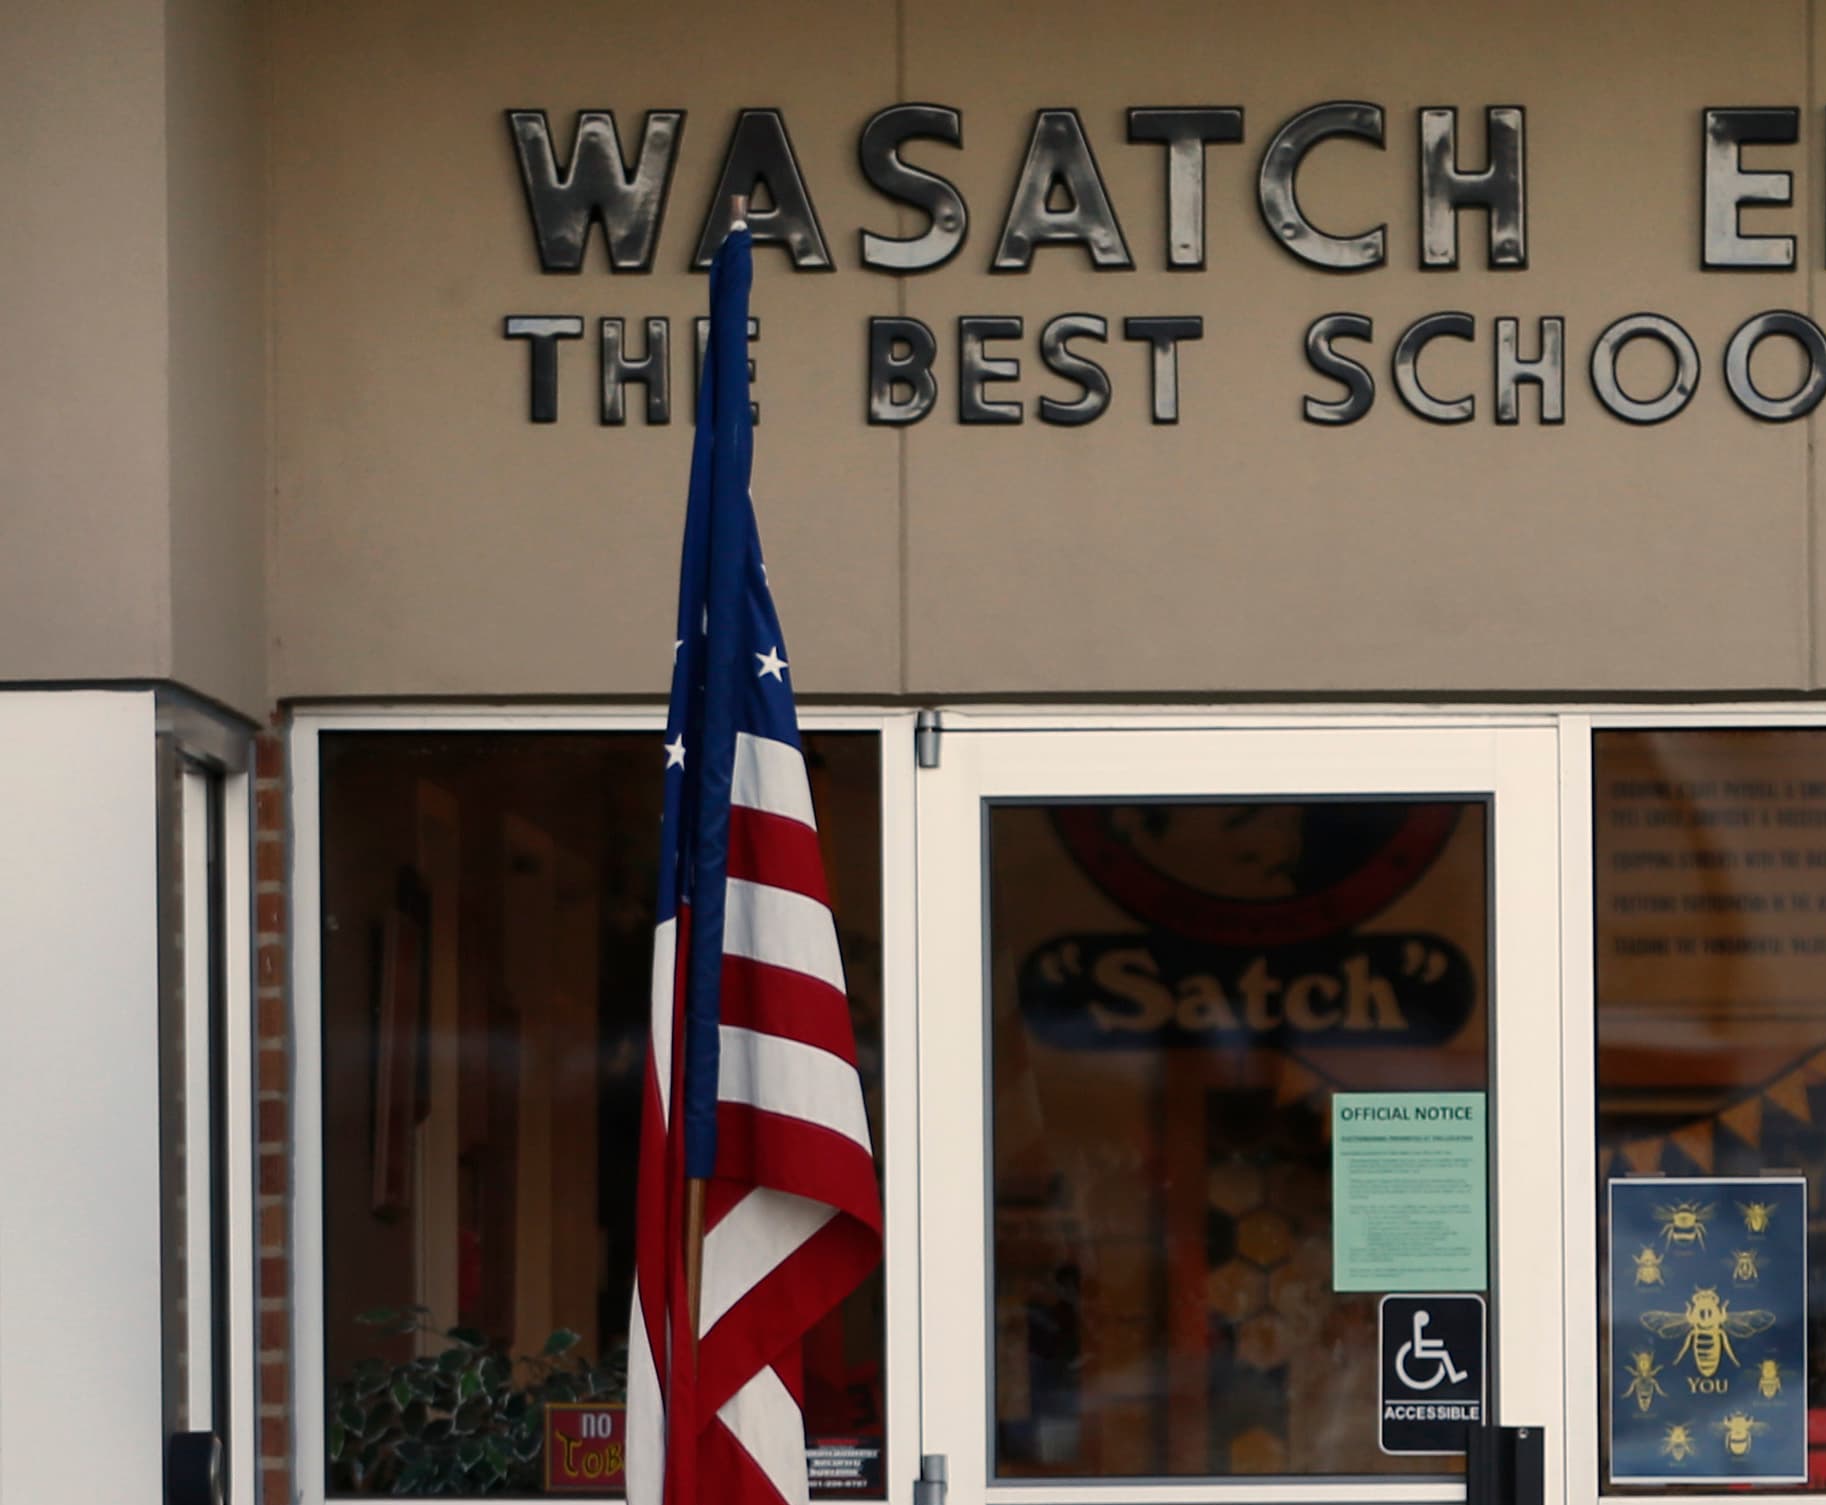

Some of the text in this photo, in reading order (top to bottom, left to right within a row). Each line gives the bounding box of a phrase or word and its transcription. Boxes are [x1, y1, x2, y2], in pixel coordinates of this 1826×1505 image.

[504, 99, 1527, 274] WASATCH
[866, 311, 1203, 427] BEST
[1341, 1106, 1473, 1121] OFFICIAL NOTICE
[1686, 1376, 1729, 1394] YOU
[1384, 1405, 1480, 1420] ACCESSIBLE
